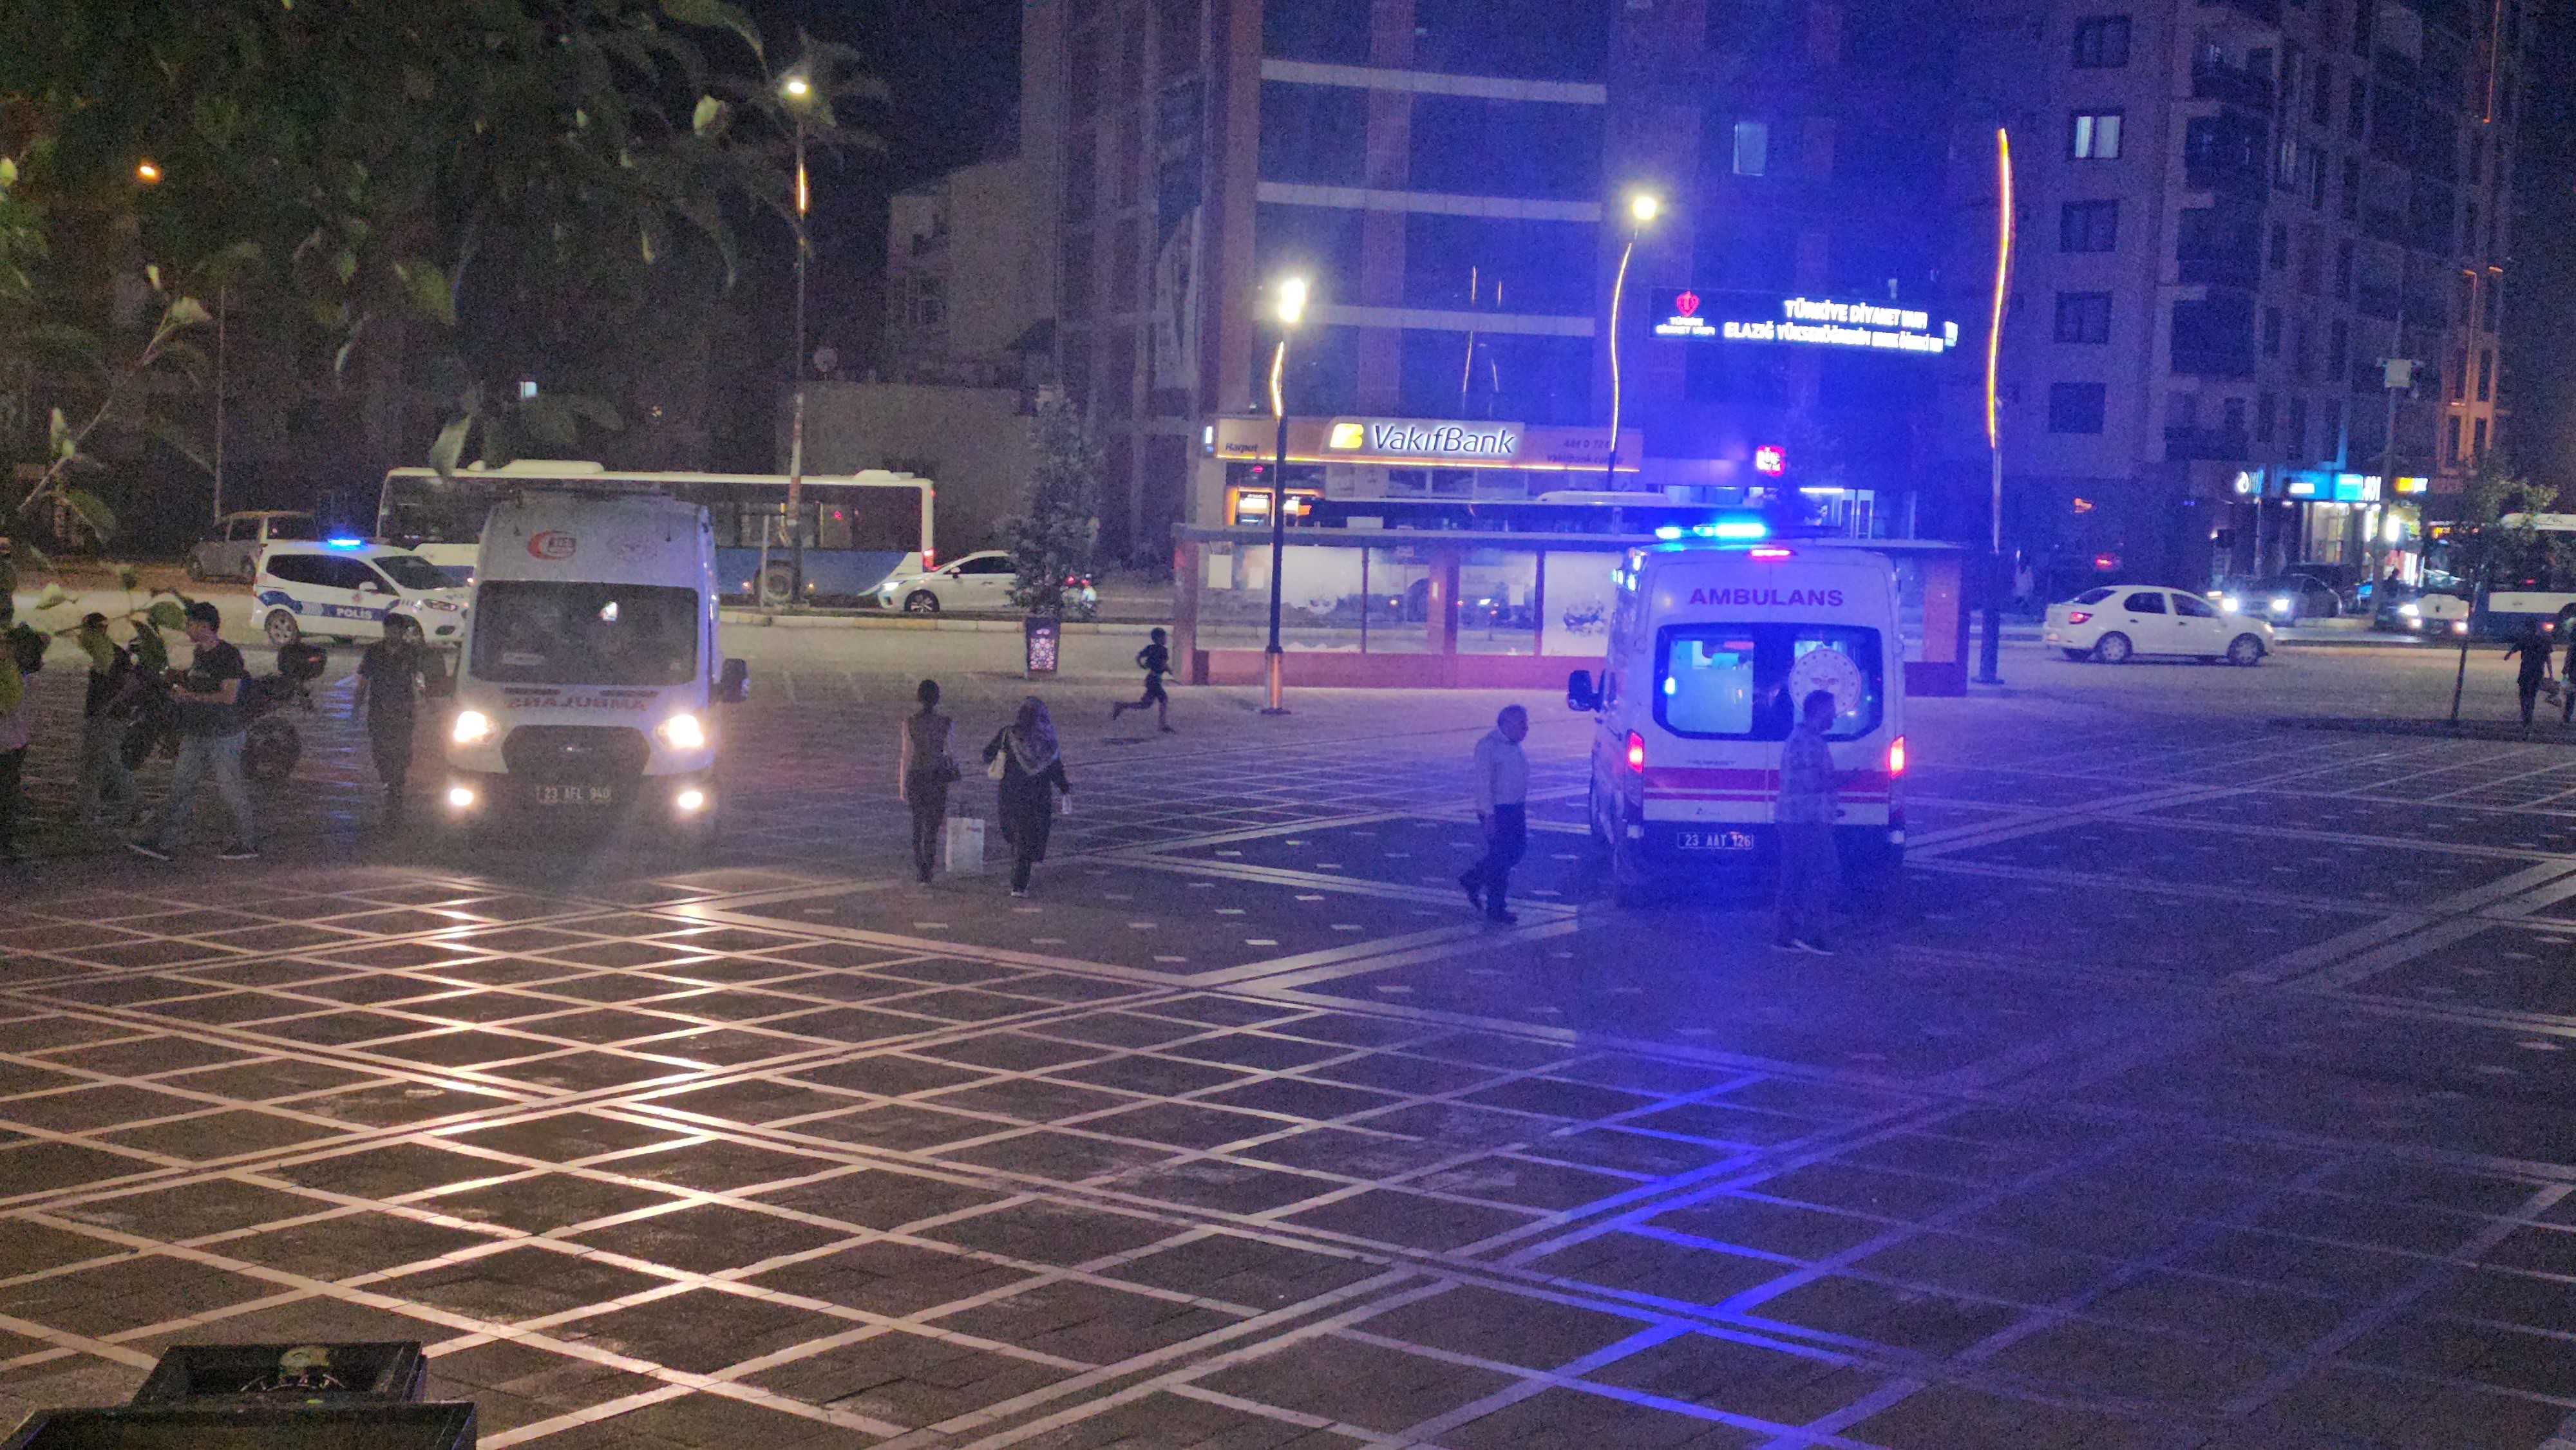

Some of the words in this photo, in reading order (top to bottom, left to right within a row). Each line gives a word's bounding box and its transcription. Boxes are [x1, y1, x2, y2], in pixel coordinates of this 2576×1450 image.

[1785, 297, 1848, 321] TÜRKİYE
[1724, 320, 1775, 339] ELAZIĞ
[1373, 424, 1517, 454] VakıfBank
[1689, 588, 1844, 607] AMBULANS
[336, 607, 373, 619] POLİS
[1685, 834, 1699, 847] 23
[1707, 834, 1727, 847] AAT
